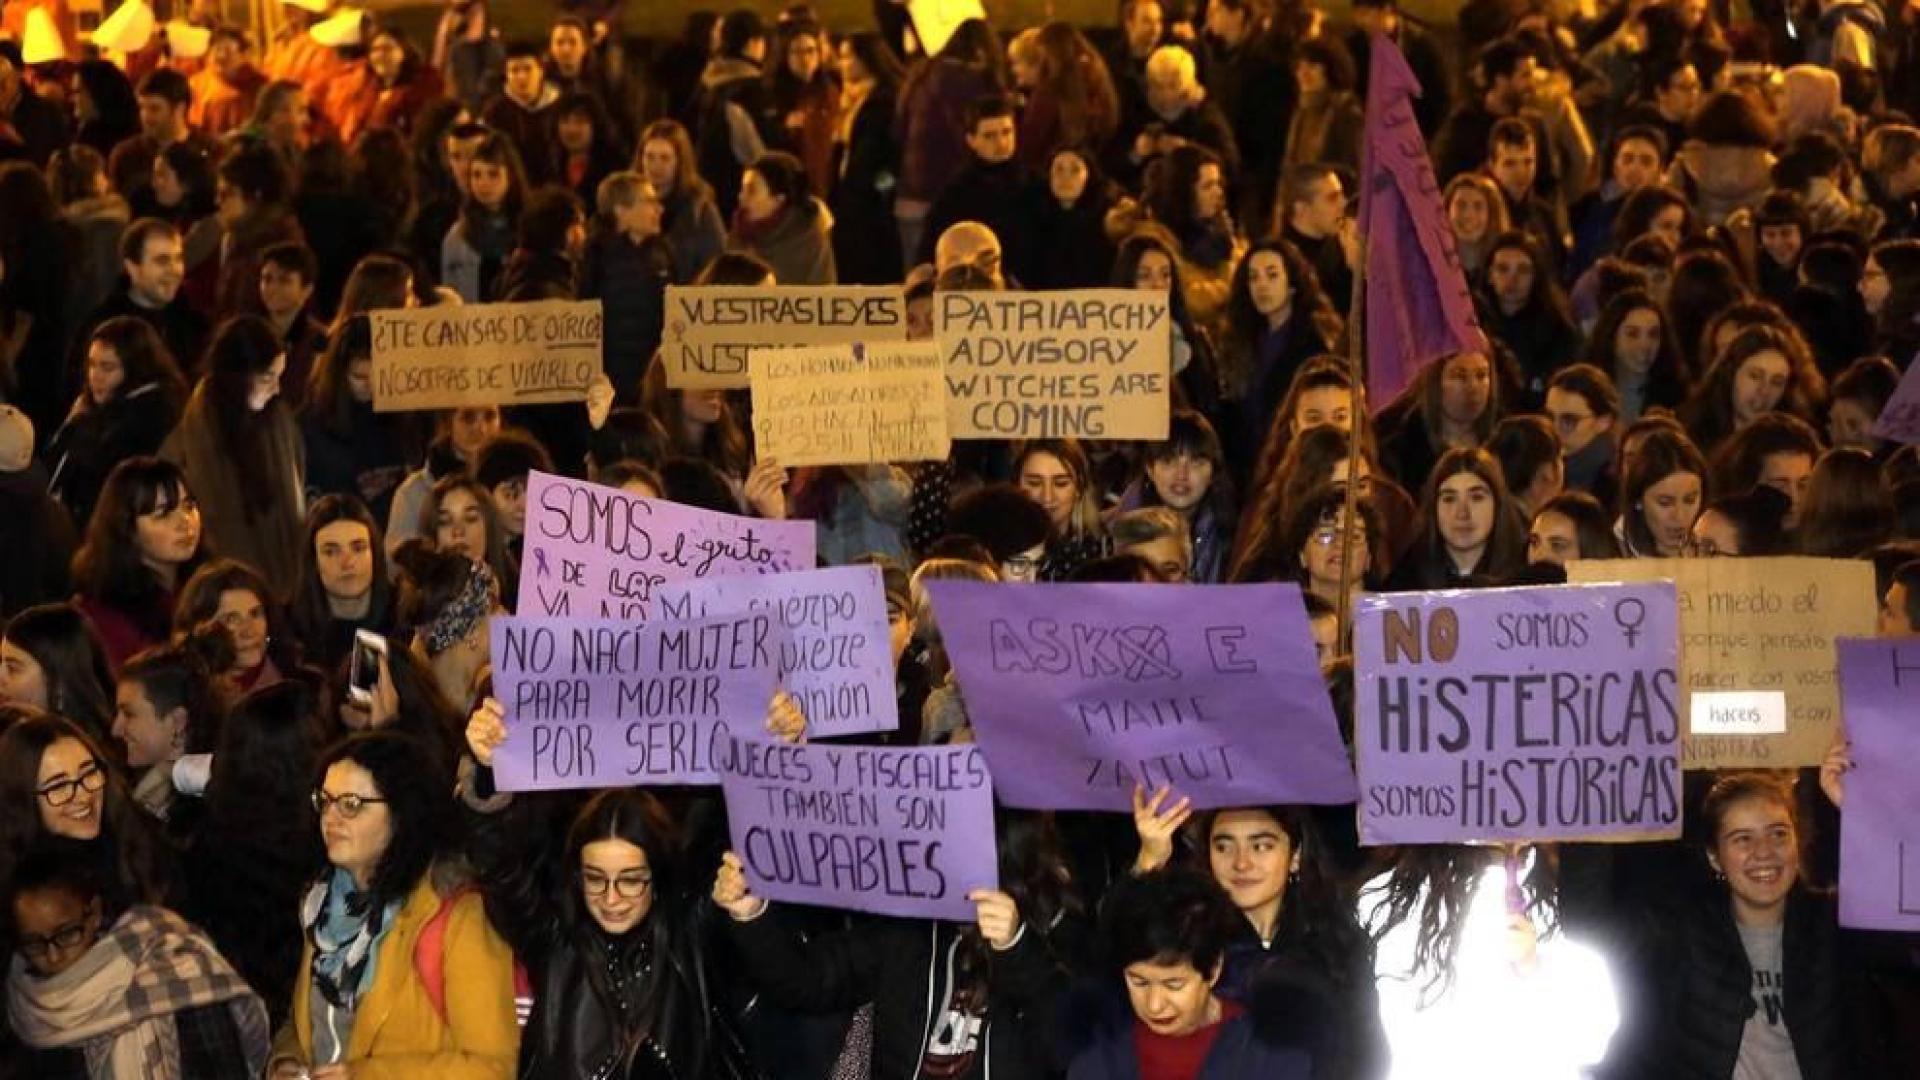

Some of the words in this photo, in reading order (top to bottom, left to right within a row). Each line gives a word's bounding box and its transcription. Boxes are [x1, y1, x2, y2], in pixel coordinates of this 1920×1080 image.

[513, 316, 538, 344] DE
[679, 297, 814, 324] VUESTRAS
[817, 297, 899, 326] LEYES
[943, 294, 1166, 332] PATRIARCHY
[949, 336, 1138, 367] ADVISORY
[477, 366, 501, 389] DE
[945, 373, 1099, 398] WITCHES
[1110, 373, 1163, 395] ARE
[972, 401, 1104, 437] COMING
[539, 483, 652, 561] SOMOS
[562, 559, 586, 586] DE
[1708, 584, 1783, 615] miedo
[1792, 582, 1818, 614] el
[503, 625, 555, 673] NO
[571, 623, 645, 675] NACÍ
[658, 614, 770, 672] MUJER
[1383, 606, 1460, 665] NO
[1496, 611, 1590, 650] SOMOS
[516, 680, 590, 720] PARA
[617, 676, 721, 719] MORIR
[533, 725, 596, 781] POR
[826, 751, 842, 785] Y
[856, 750, 985, 792] FISCALES
[760, 786, 879, 828] TAMBIÉN
[896, 795, 945, 831] SON
[1368, 785, 1456, 818] SOMOS
[744, 826, 946, 899] CULPABLES
